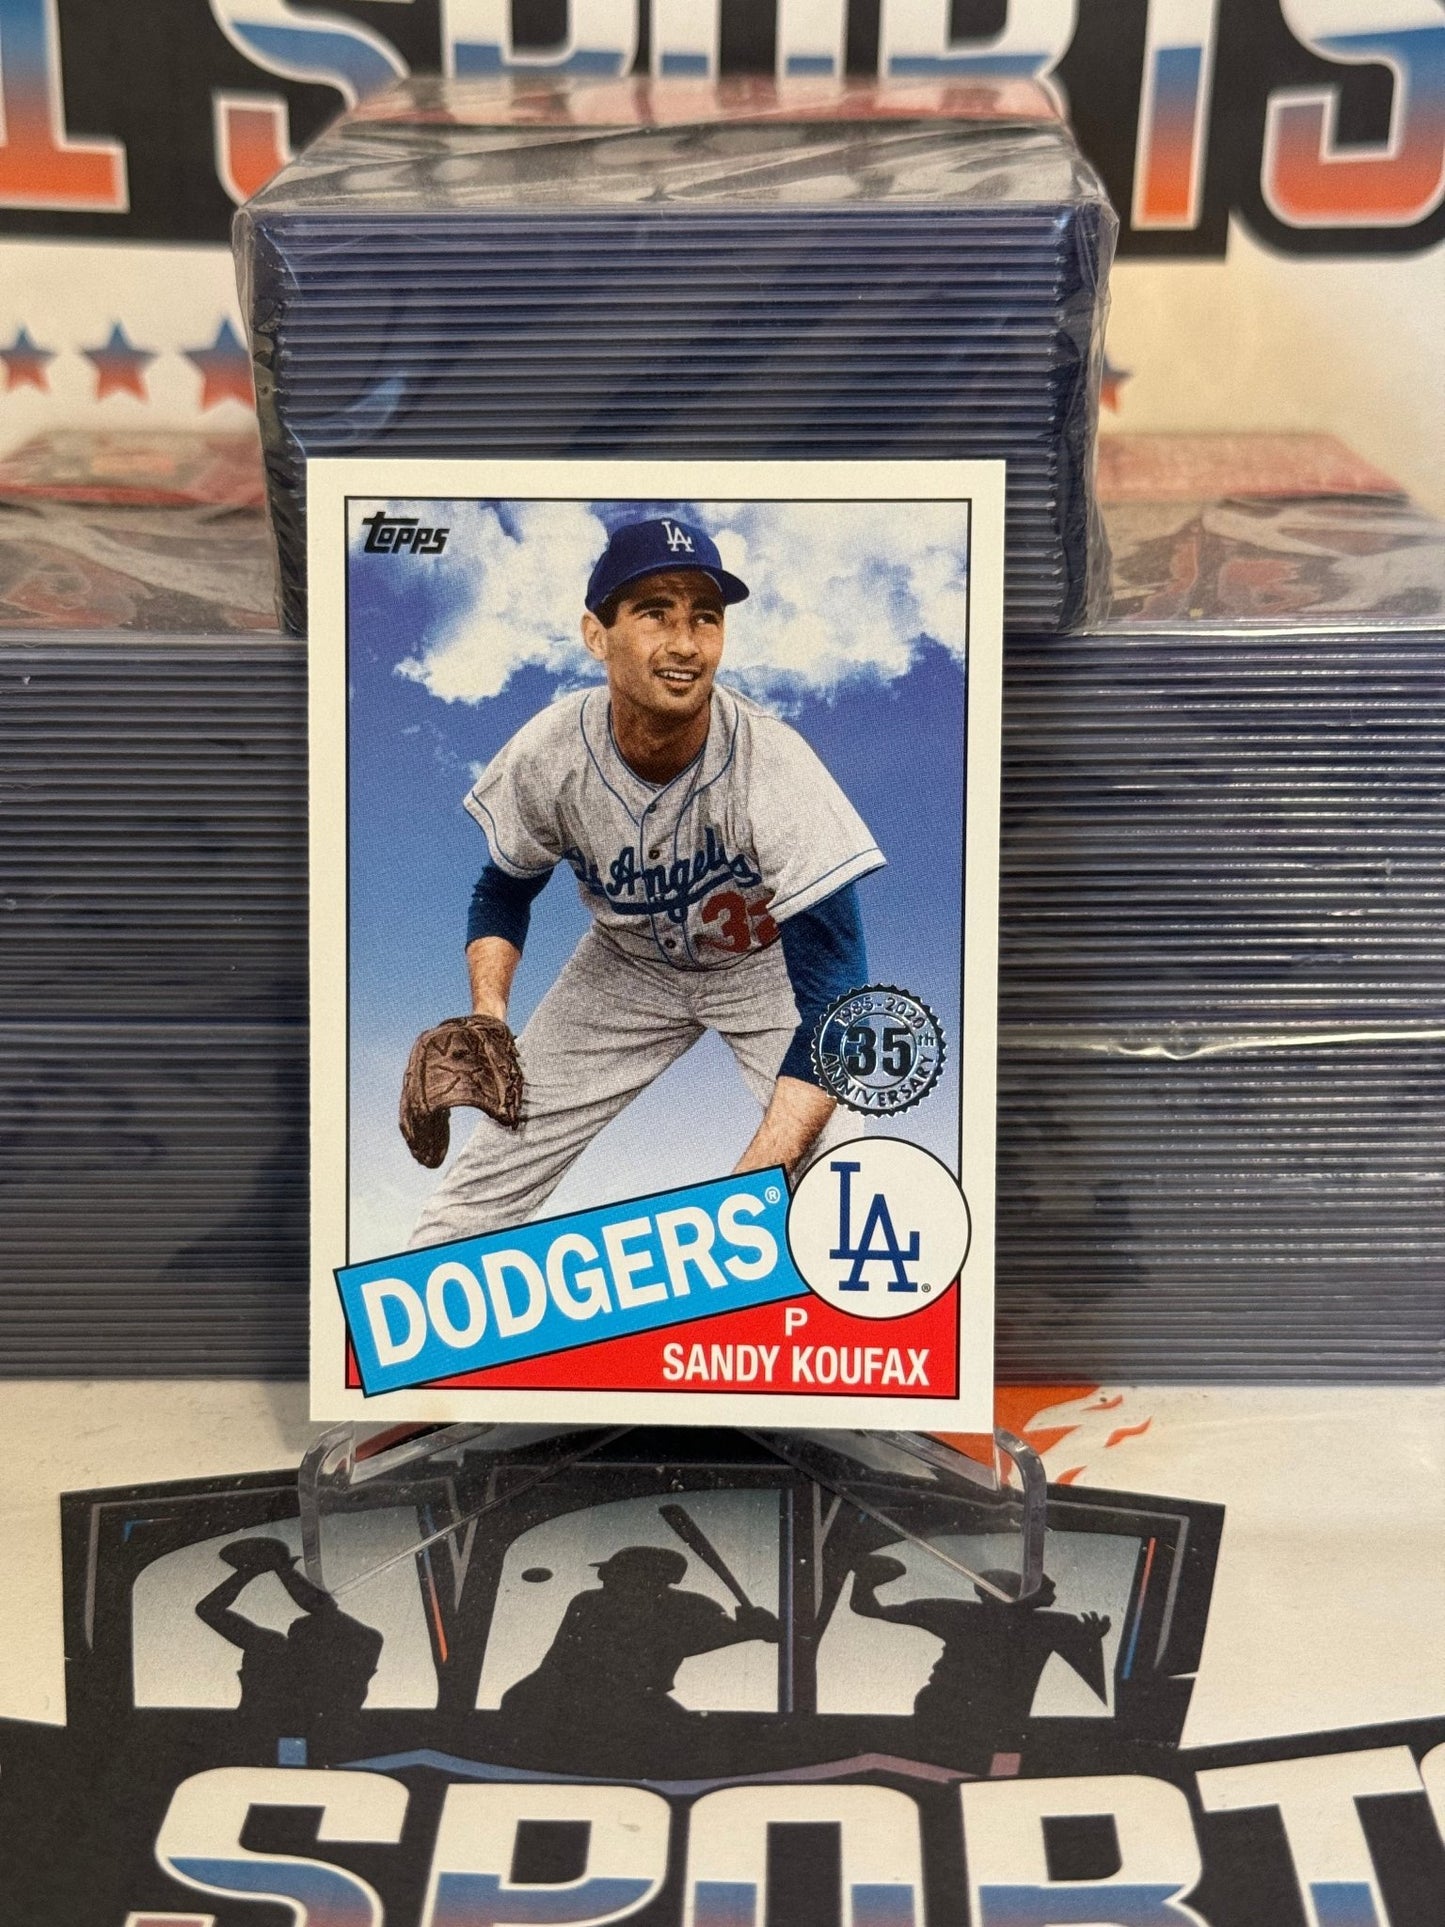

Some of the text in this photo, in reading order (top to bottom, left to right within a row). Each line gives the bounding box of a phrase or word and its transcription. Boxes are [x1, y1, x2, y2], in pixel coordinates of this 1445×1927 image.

[661, 520, 696, 553] LA
[820, 1052, 937, 1108] ANNIVERSARY
[784, 1306, 809, 1337] P
[661, 1341, 931, 1387] SANDY KOUFAX
[122, 1743, 1445, 1927] SPORT
